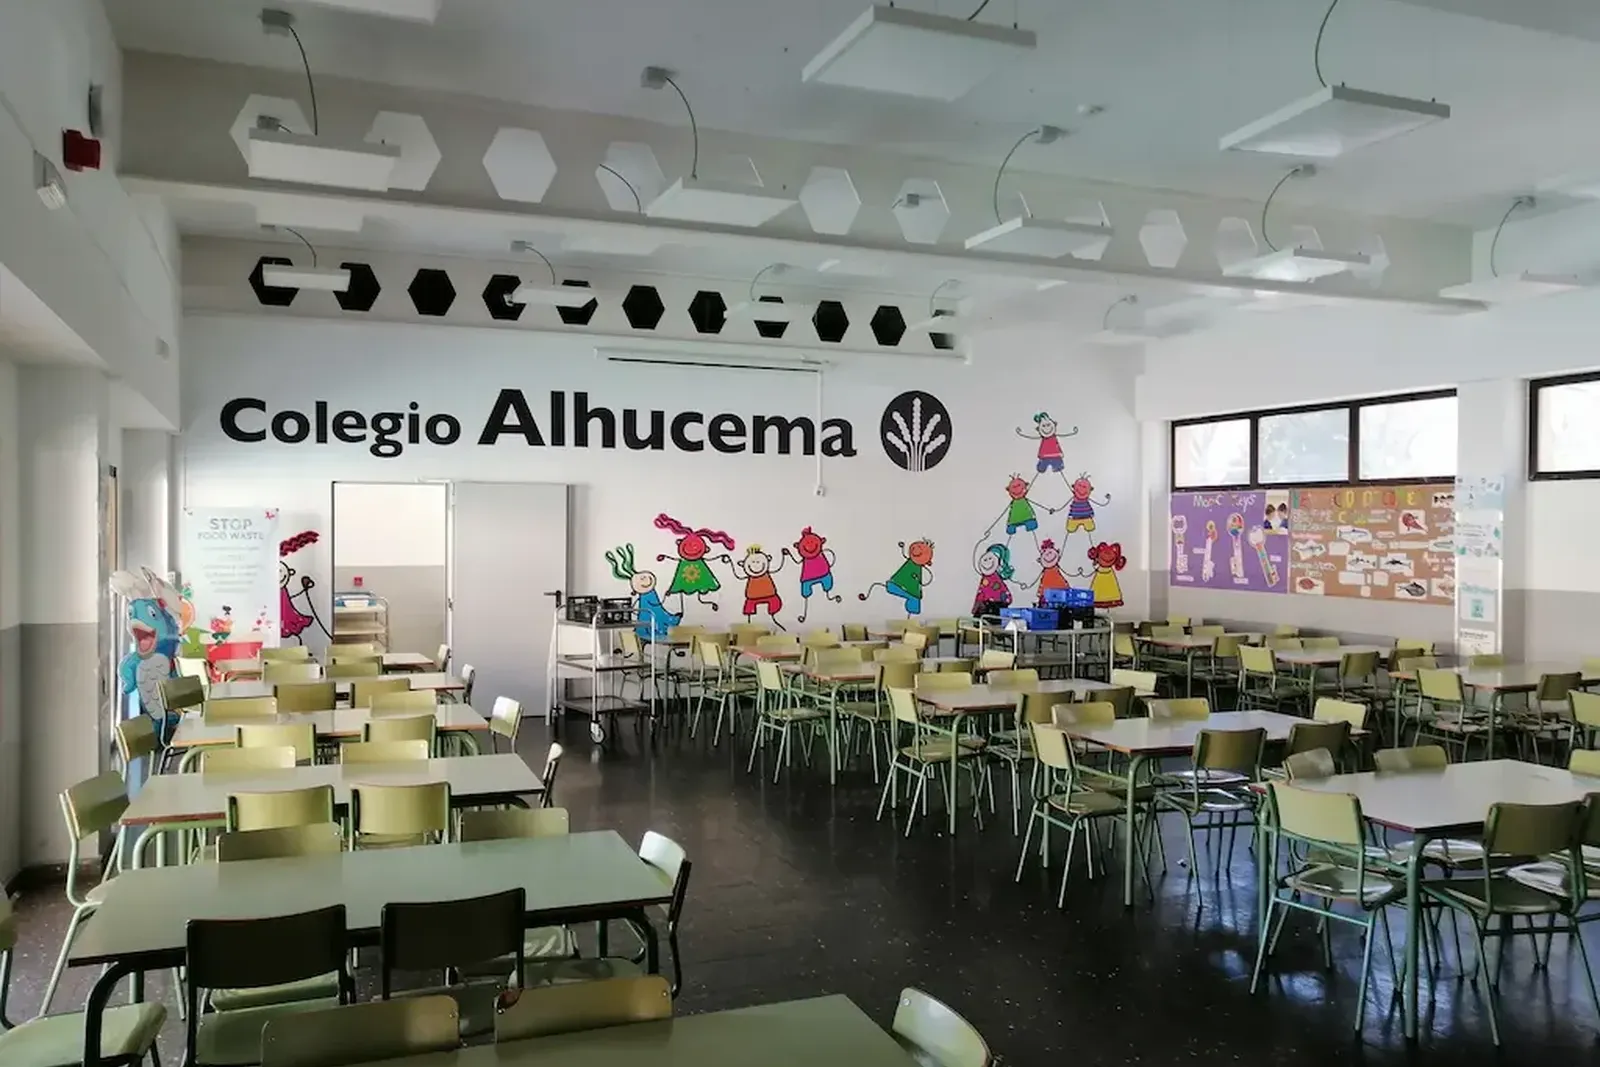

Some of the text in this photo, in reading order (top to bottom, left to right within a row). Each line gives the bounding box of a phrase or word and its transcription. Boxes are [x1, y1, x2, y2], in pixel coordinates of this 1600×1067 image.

[220, 388, 857, 458] Colegio Alhucema
[209, 518, 252, 530] STOP
[197, 531, 227, 540] FOOD
